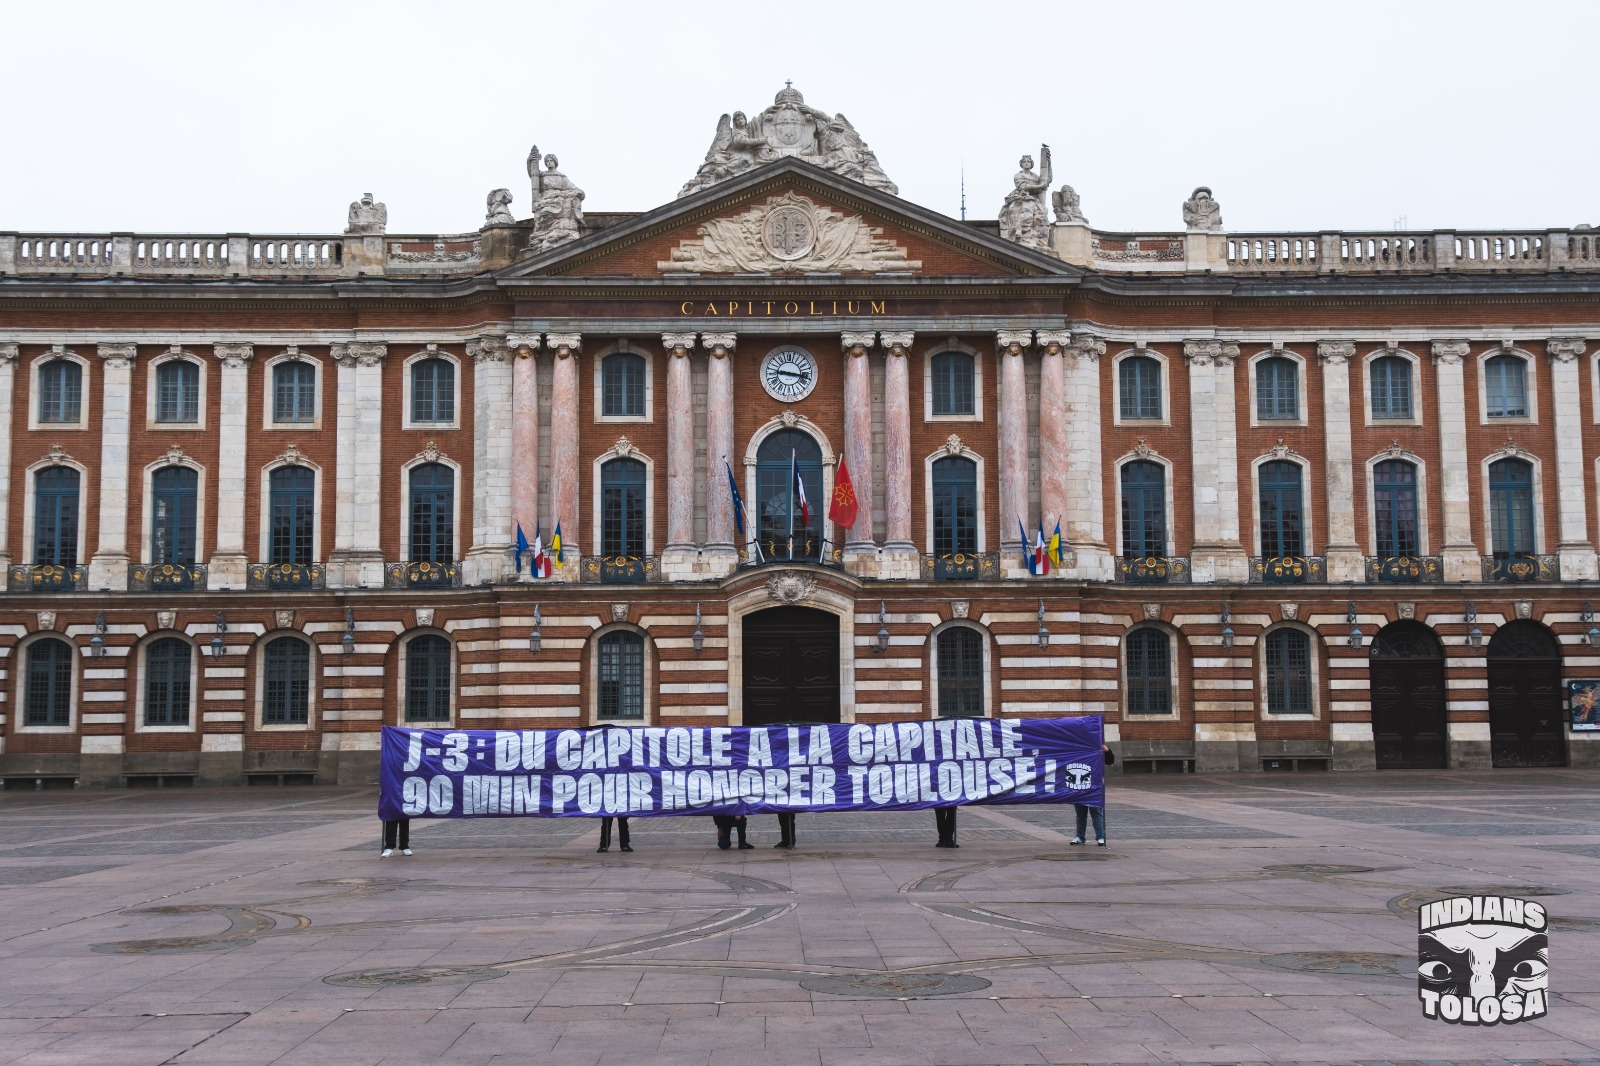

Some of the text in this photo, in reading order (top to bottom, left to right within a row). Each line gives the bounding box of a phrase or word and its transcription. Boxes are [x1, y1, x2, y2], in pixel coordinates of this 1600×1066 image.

[681, 301, 886, 315] CAPITOLIUM
[496, 731, 546, 770] DU
[556, 727, 732, 770] CAPITOLE
[748, 728, 772, 766] A
[788, 725, 833, 765] LA
[402, 775, 453, 815] 90
[463, 775, 541, 814] MIN
[552, 772, 653, 813] POUR
[661, 766, 836, 810] HONORER
